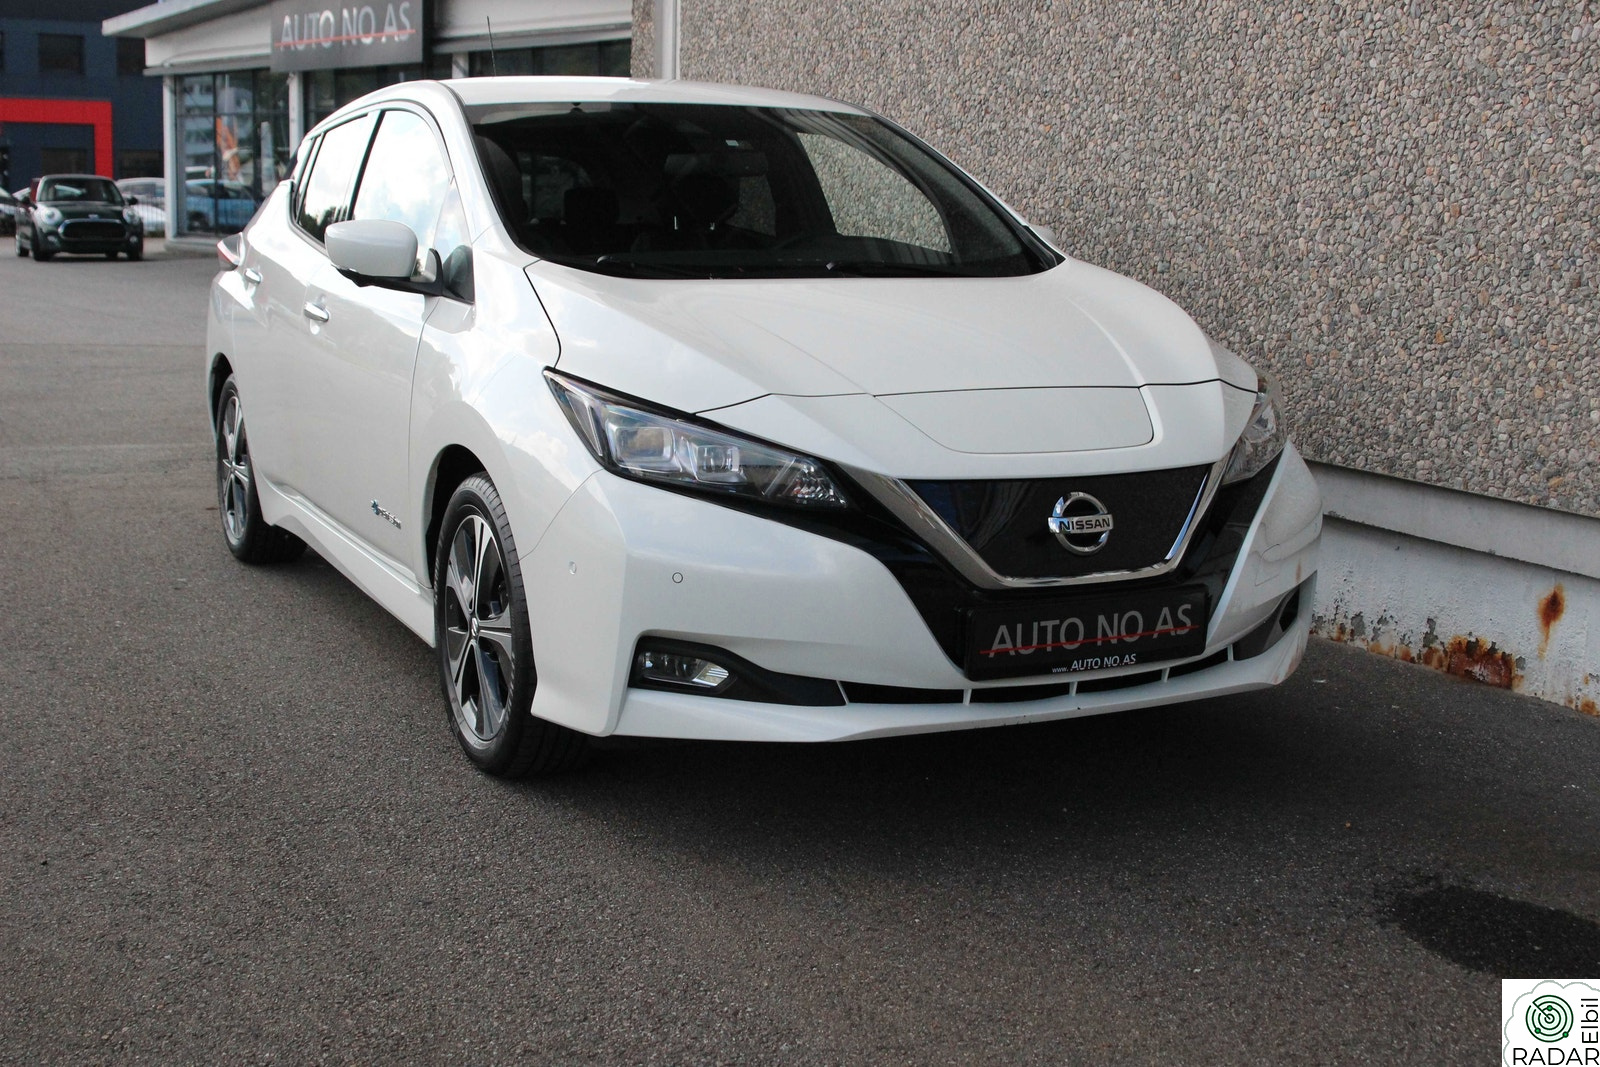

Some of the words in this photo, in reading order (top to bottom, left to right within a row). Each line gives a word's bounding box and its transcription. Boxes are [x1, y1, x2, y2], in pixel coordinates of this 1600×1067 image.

[281, 10, 335, 50] AUTO
[342, 6, 375, 46] NO
[381, 2, 411, 43] AS
[1060, 518, 1110, 530] NISSAN
[988, 617, 1085, 658] AUTO
[1097, 610, 1143, 646] NO
[1152, 603, 1192, 640] AS
